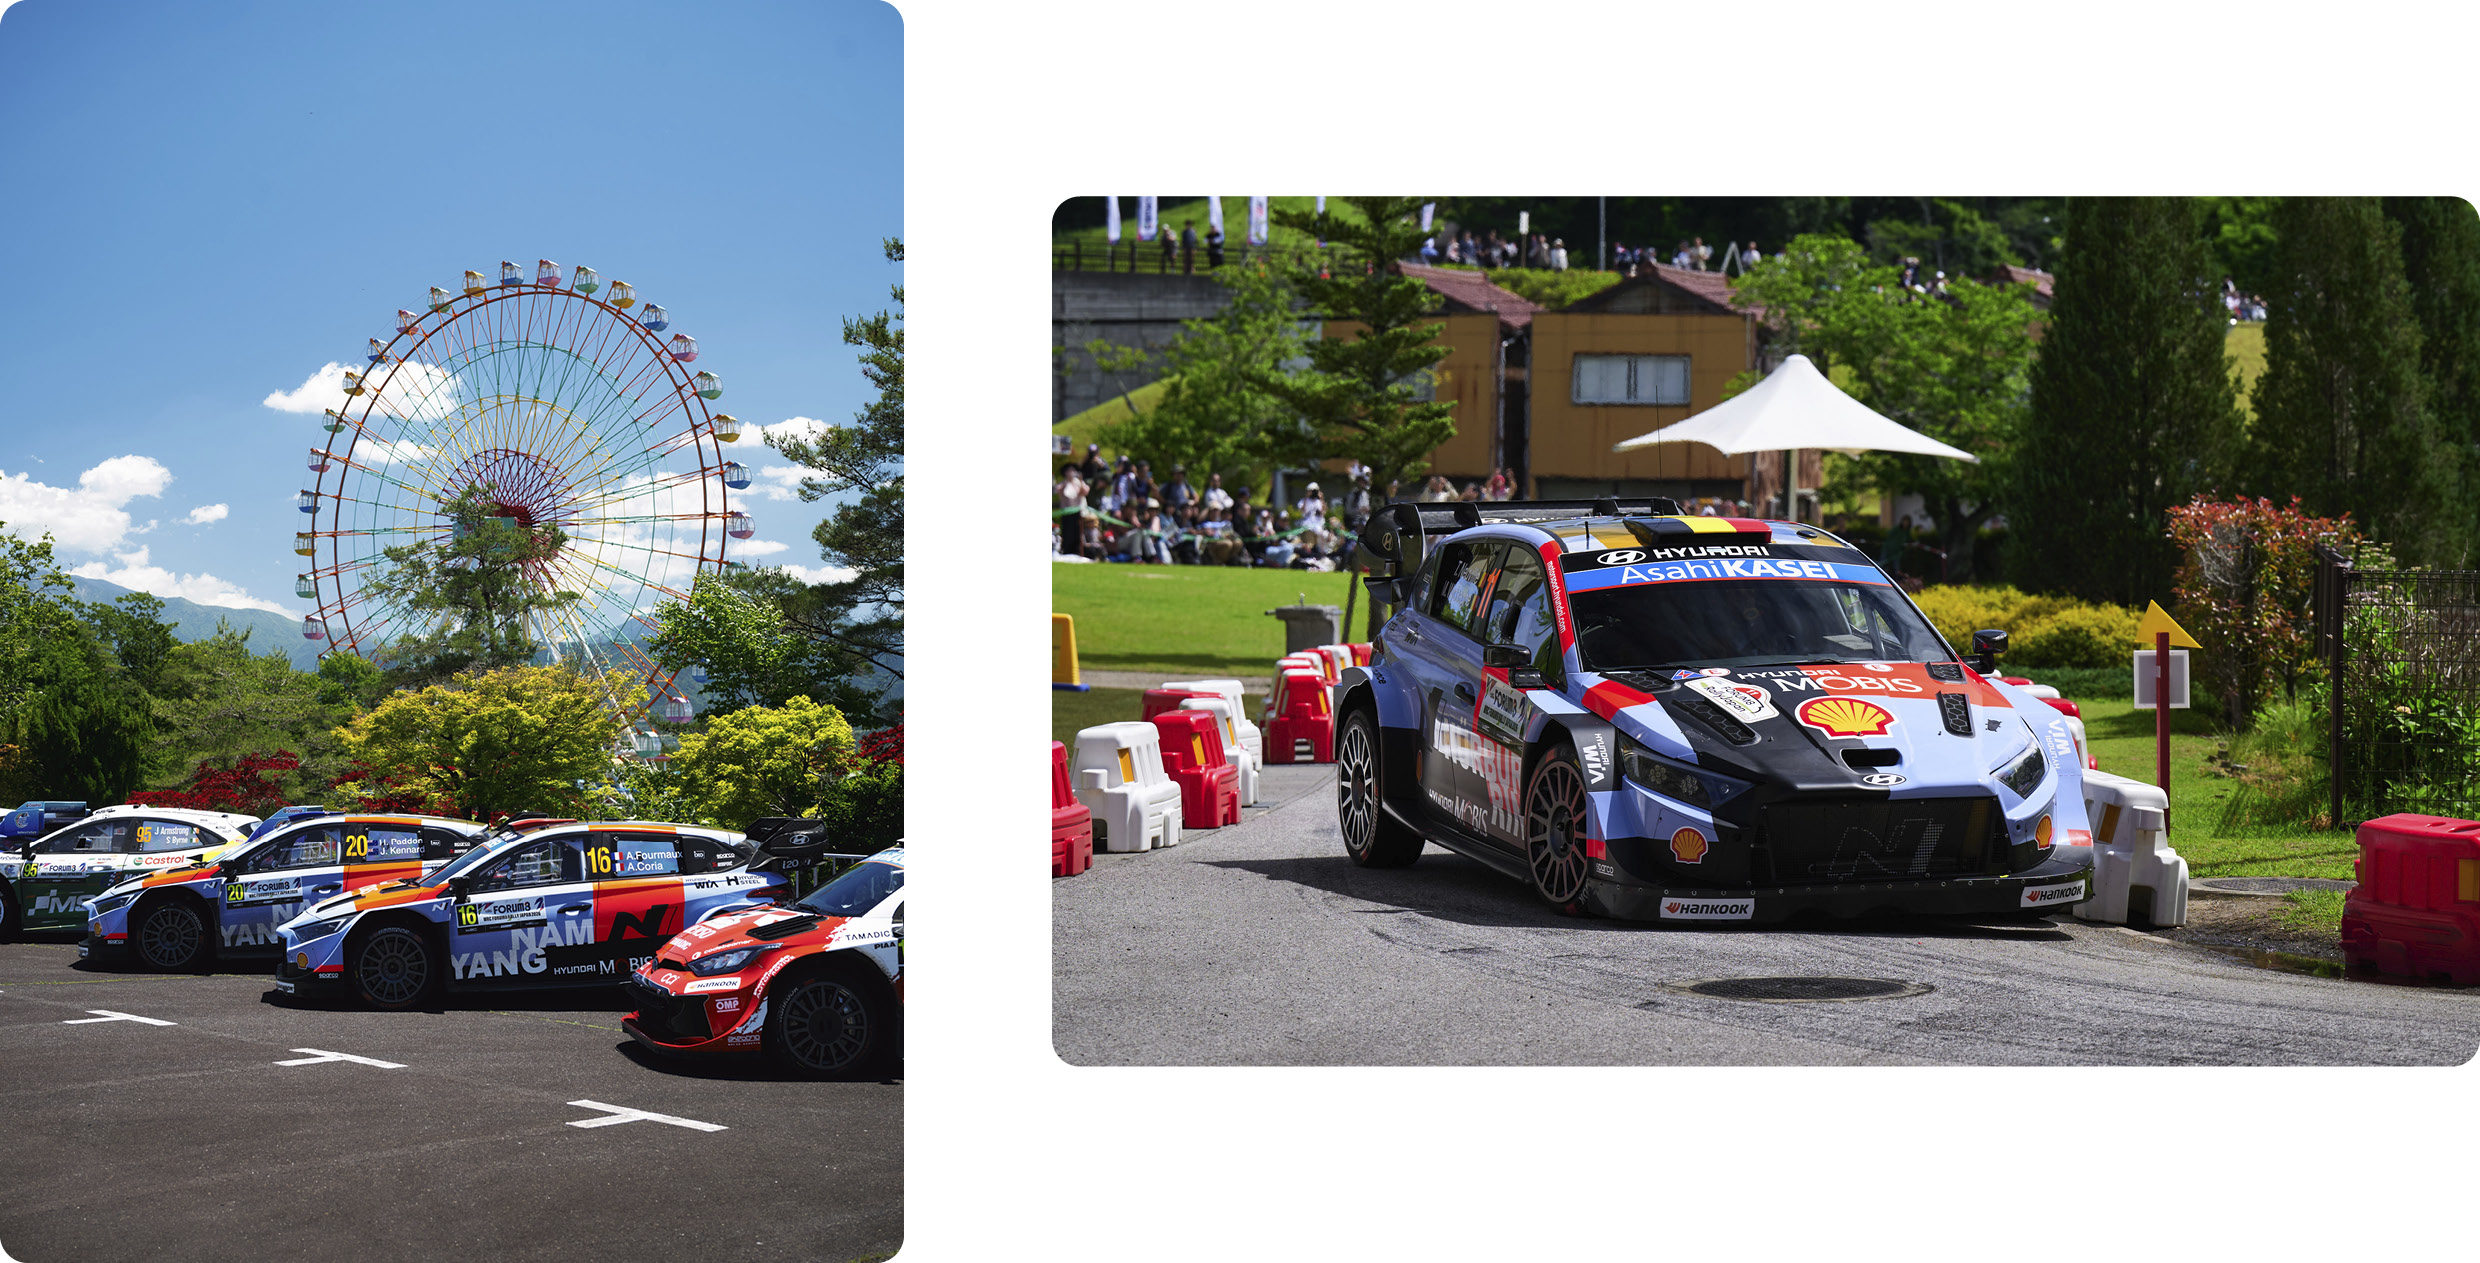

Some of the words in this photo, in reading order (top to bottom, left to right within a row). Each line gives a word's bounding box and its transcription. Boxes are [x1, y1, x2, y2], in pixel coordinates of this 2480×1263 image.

[1653, 546, 1769, 559] HYUNDAI
[1547, 560, 1566, 634] motorsport.hyundai.com
[1737, 669, 1842, 680] HYUNDAI
[1771, 676, 1923, 693] MOBIS
[2048, 719, 2071, 755] WIA
[1595, 733, 1610, 765] HYUNDAI
[2045, 735, 2060, 769] HYUNDAI
[1582, 744, 1605, 785] WIA
[136, 826, 152, 843] 95
[160, 826, 189, 836] Armstrong
[172, 836, 188, 844] Byrne
[346, 835, 368, 856] 20
[391, 838, 423, 846] Paddon
[390, 845, 425, 854] Kennard
[145, 855, 184, 865] Castrol
[587, 846, 612, 873] 16
[23, 863, 38, 877] 95
[1596, 863, 1614, 875] sparco
[227, 884, 244, 901] 20
[258, 882, 290, 893] FORUM8
[458, 905, 477, 925] 16
[493, 902, 531, 914] FORUM8
[511, 919, 595, 950] NAM
[845, 930, 890, 941] TAMADIC
[874, 941, 896, 949] PIAA
[451, 947, 547, 980] YANG
[554, 964, 596, 975] HYUNDAI
[716, 1000, 740, 1010] OMP
